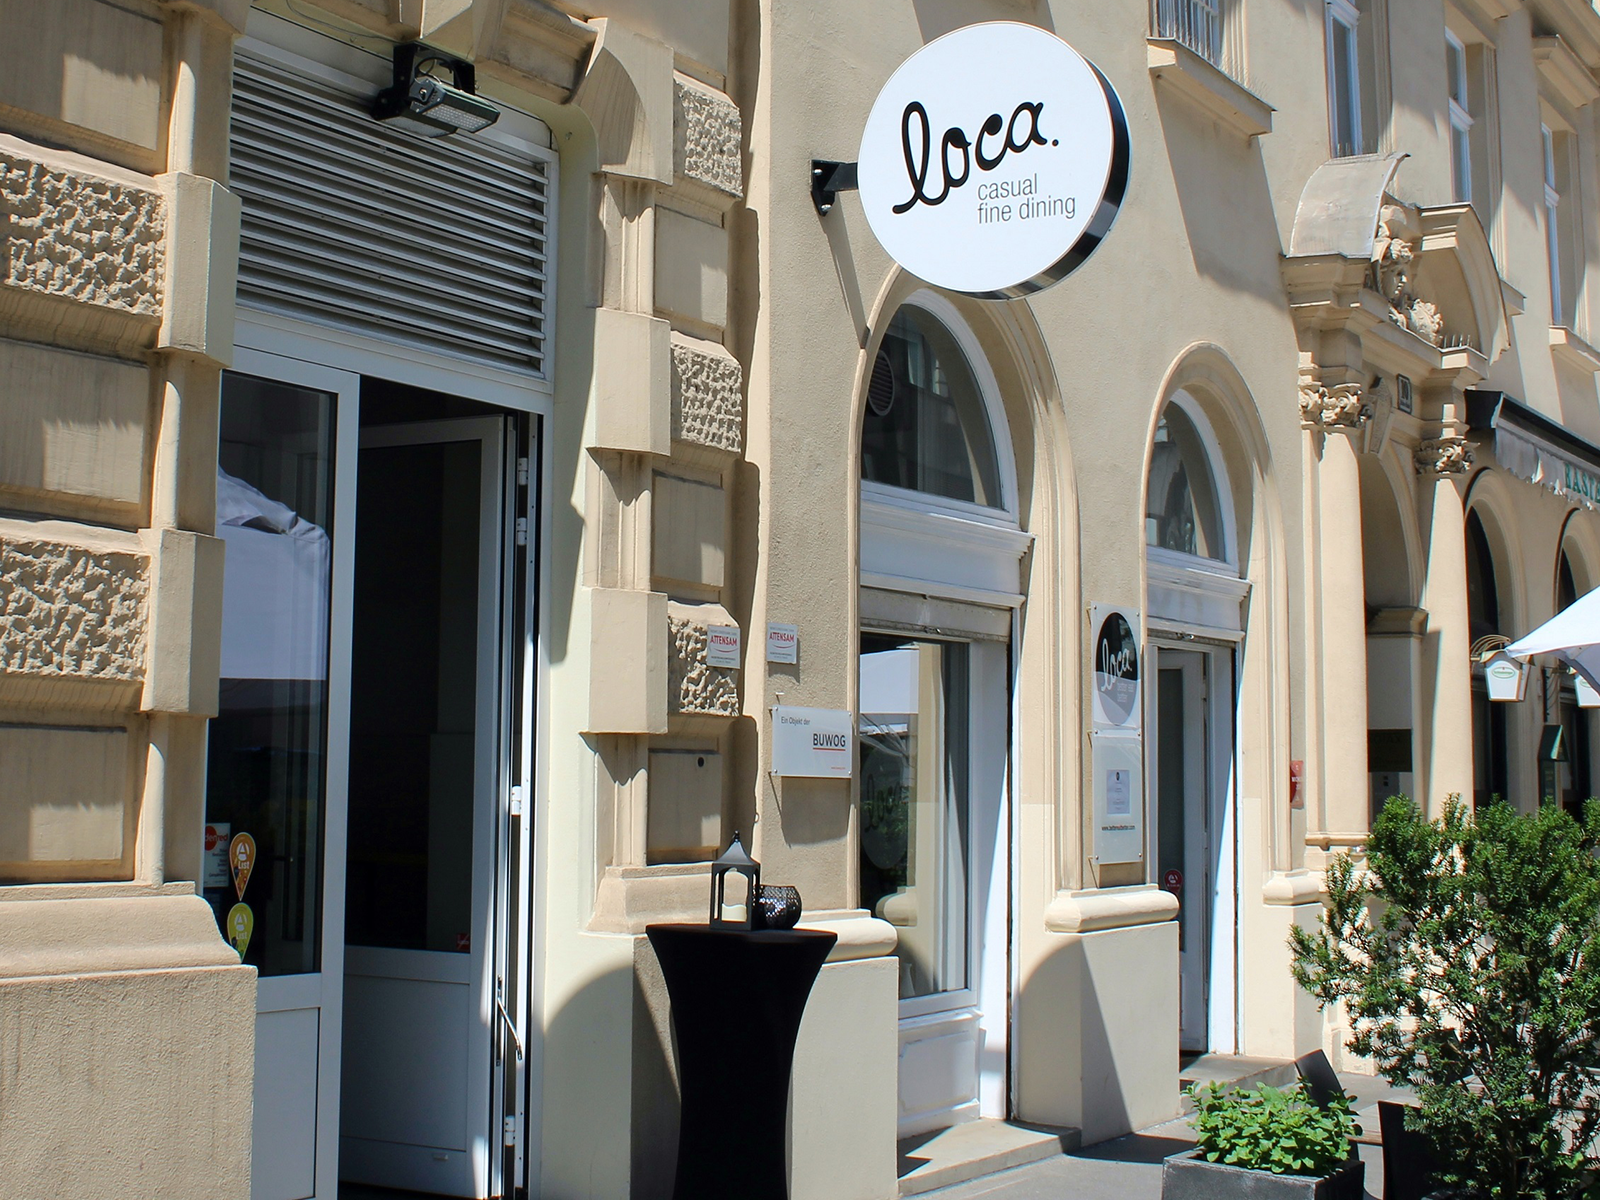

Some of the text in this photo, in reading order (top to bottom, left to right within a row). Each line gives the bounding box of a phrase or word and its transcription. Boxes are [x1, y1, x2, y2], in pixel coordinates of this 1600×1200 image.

[978, 173, 1038, 200] casual
[978, 196, 1076, 224] fine dining
[710, 635, 737, 646] ATTENSAM
[769, 632, 795, 643] ATTENSAM
[781, 716, 789, 724] Ein
[789, 716, 803, 725] Objekt
[813, 733, 846, 747] BUWOG
[238, 861, 250, 869] List
